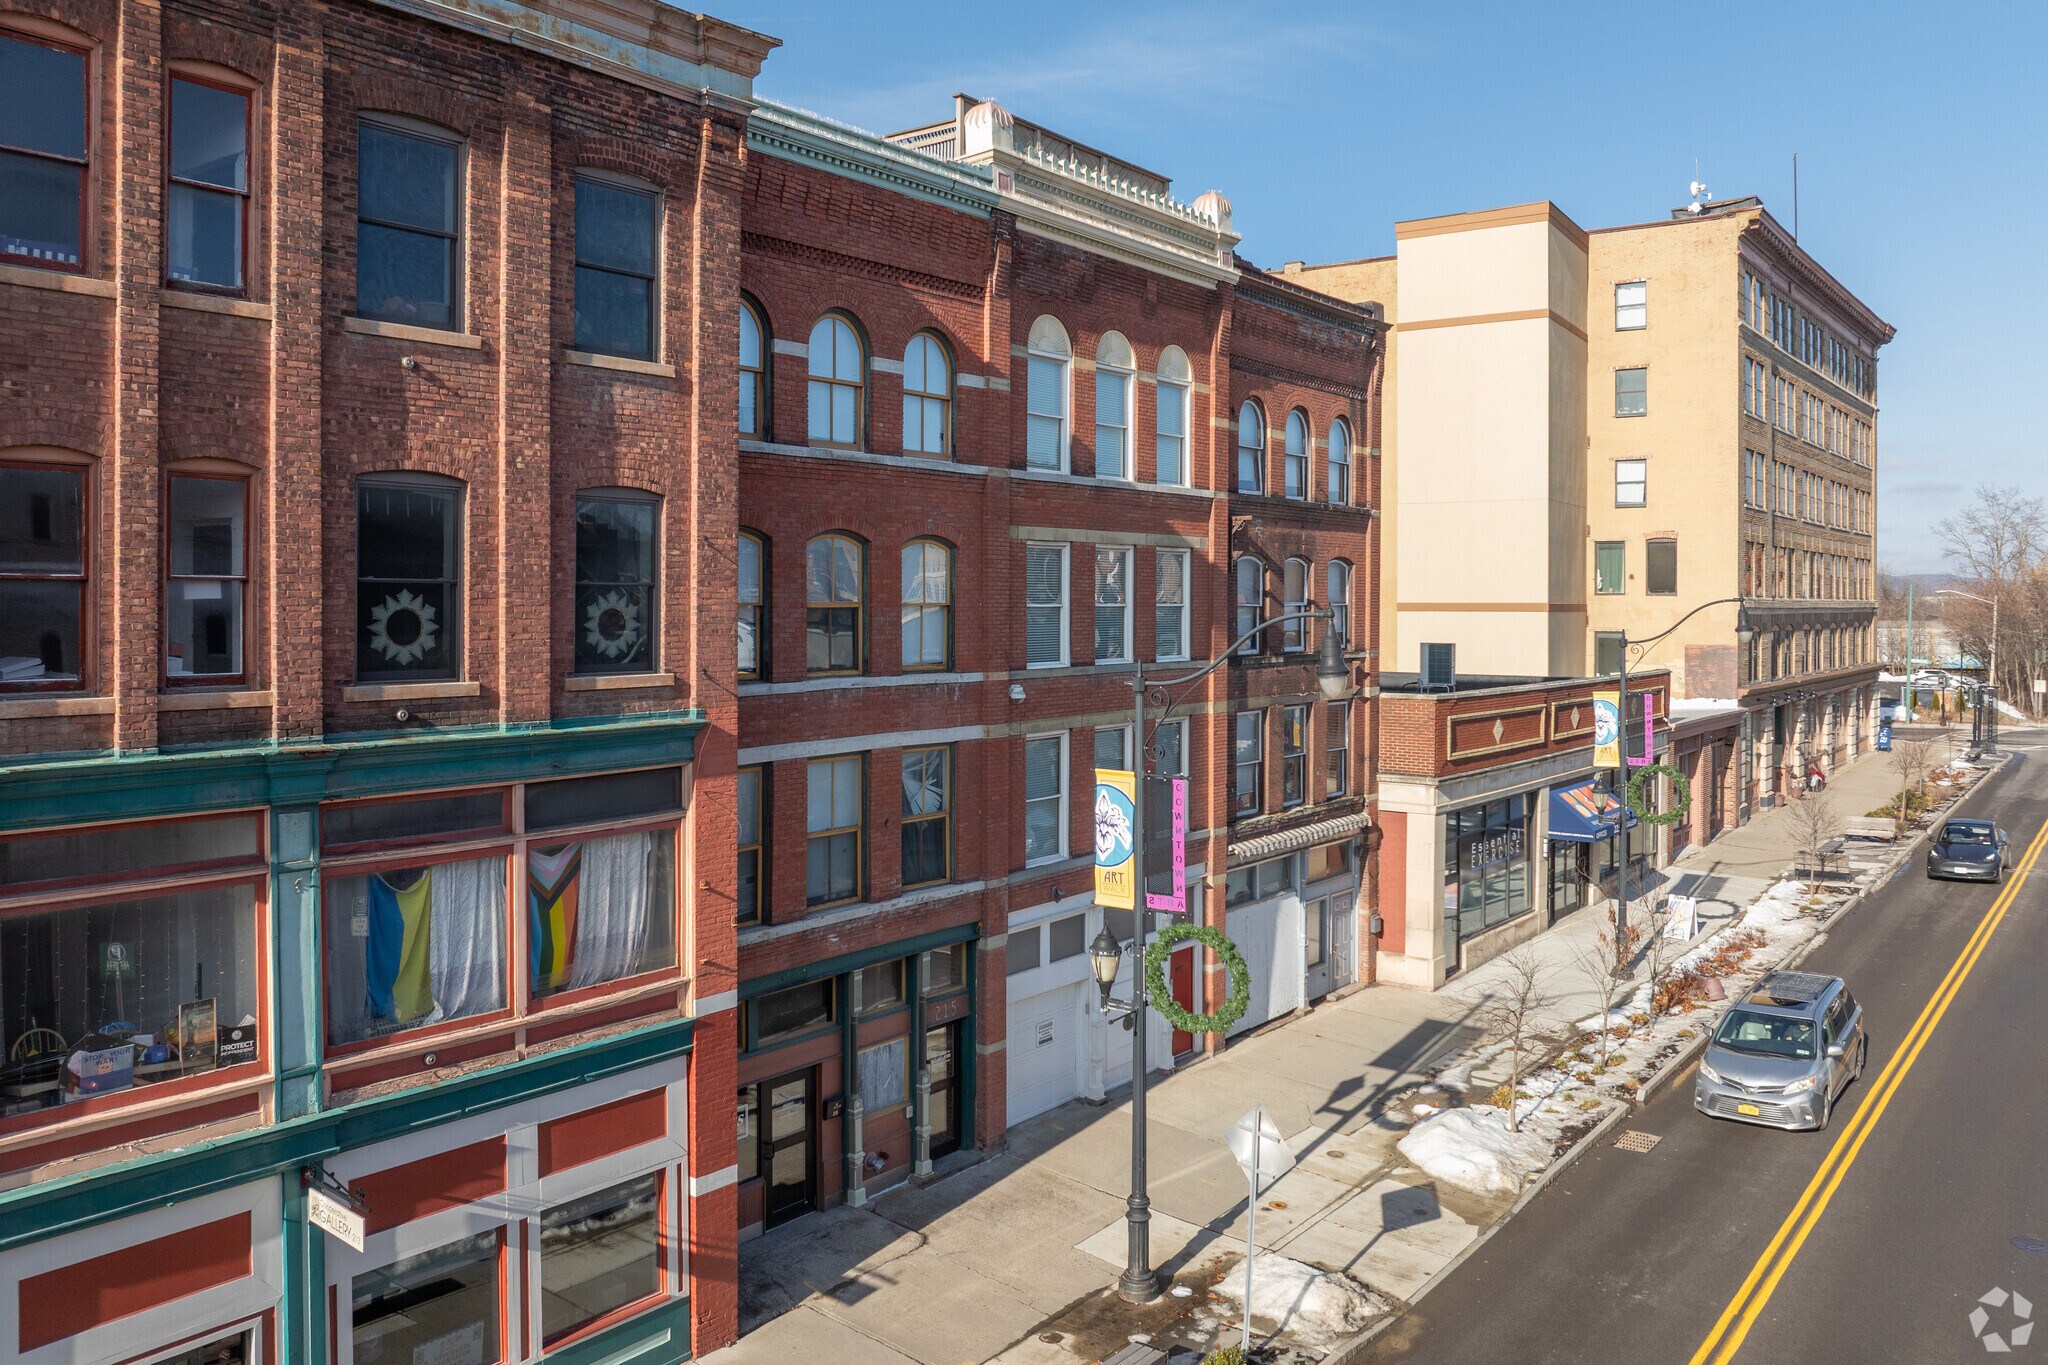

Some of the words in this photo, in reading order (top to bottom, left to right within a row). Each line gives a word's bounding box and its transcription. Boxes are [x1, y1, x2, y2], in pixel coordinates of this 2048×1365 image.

[1471, 829, 1520, 854] Essental
[1104, 871, 1124, 884] ART
[1102, 884, 1126, 894] WALK
[935, 1000, 957, 1020] 215
[220, 1047, 254, 1057] INDEPENDENT
[221, 1040, 254, 1052] PROTECT
[83, 1053, 104, 1063] STOP
[110, 1047, 131, 1056] YOUR
[320, 1209, 352, 1238] GALLERY
